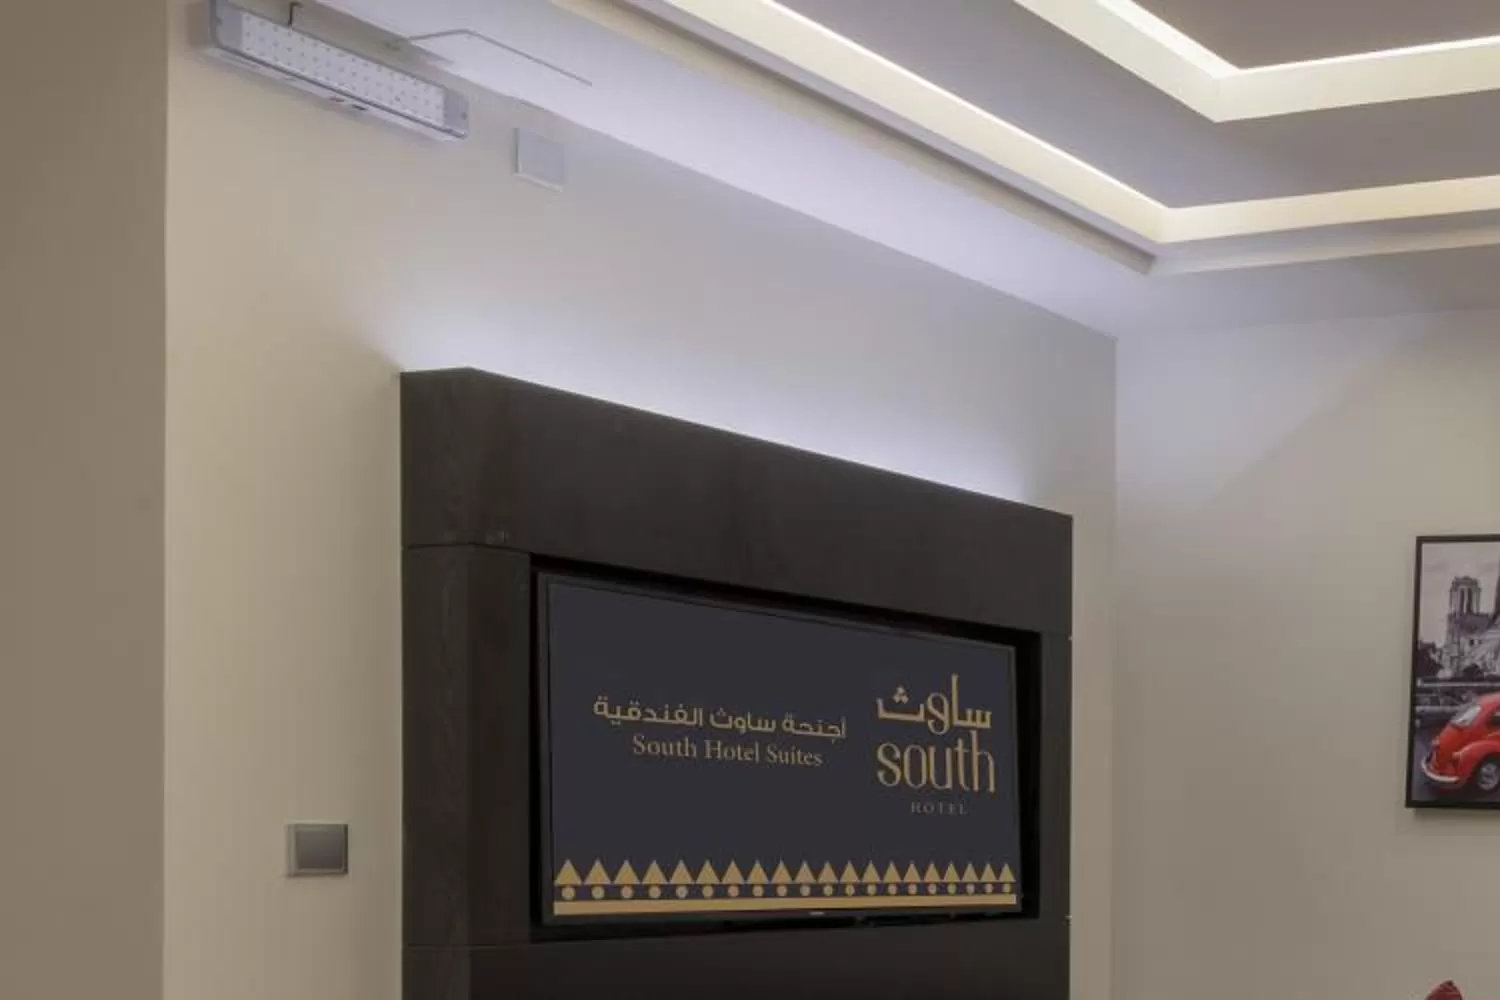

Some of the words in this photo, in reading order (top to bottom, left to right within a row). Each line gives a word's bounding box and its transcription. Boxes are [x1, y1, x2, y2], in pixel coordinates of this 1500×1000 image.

[593, 695, 703, 726] الفندقية
[876, 673, 992, 735] ساوث
[709, 707, 776, 734] ساوث
[632, 733, 697, 758] South
[704, 739, 760, 764] Hotel
[765, 743, 823, 767] Suites
[876, 729, 995, 793] south
[911, 801, 968, 815] HOTEL
